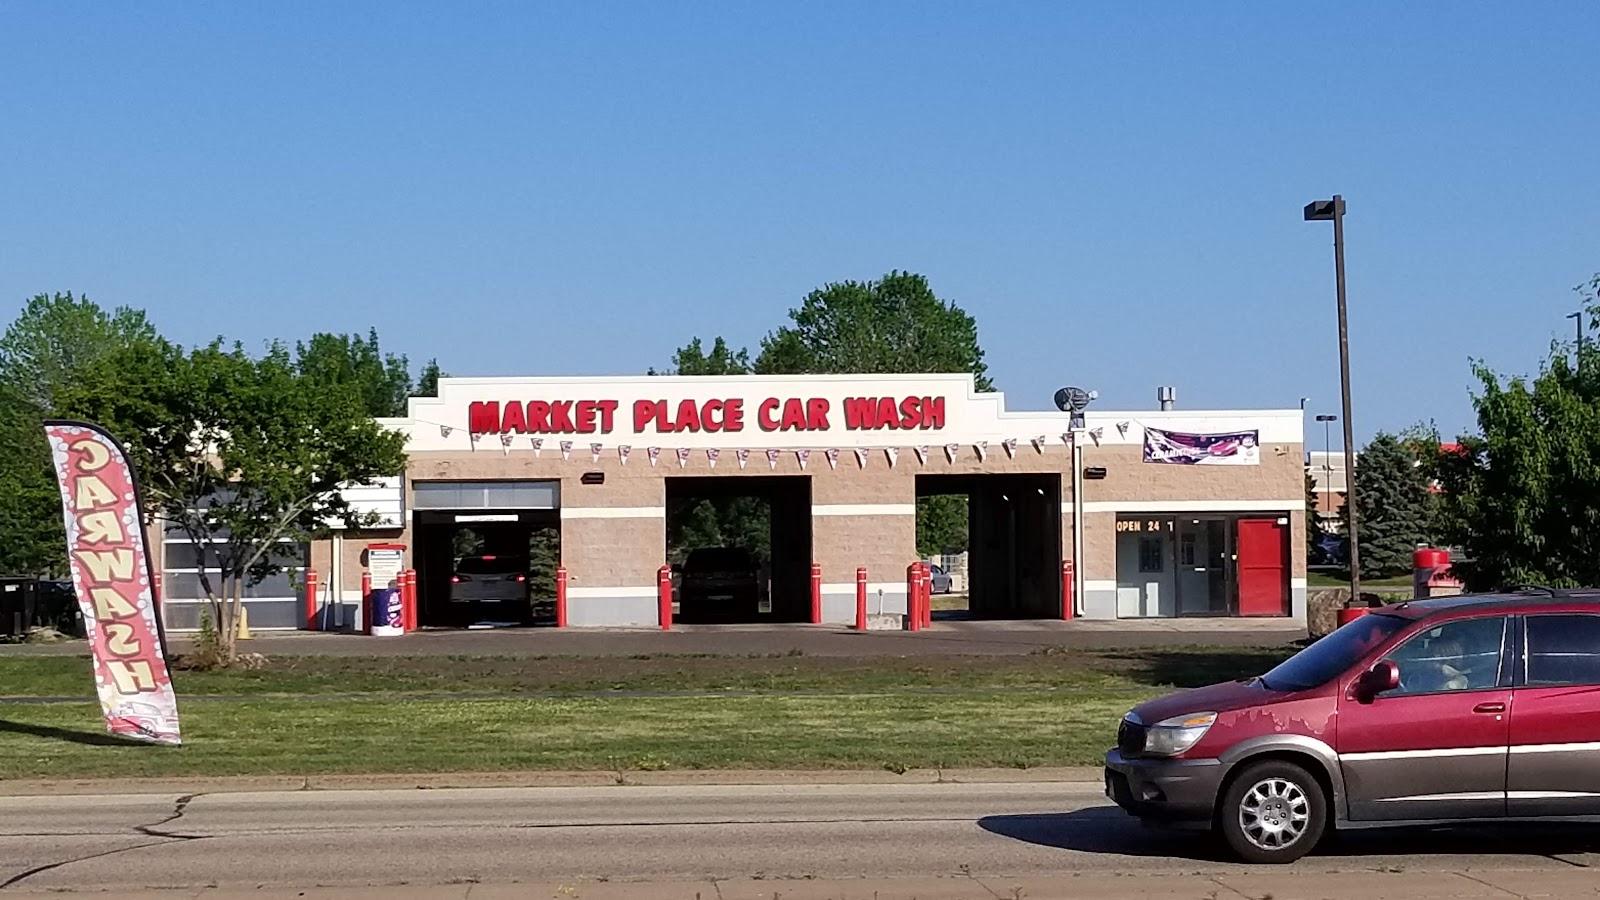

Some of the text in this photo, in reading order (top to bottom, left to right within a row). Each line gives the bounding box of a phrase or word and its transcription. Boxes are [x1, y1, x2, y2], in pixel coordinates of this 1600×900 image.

[468, 396, 946, 435] MARKET PLACE CAR WASH
[1116, 520, 1141, 532] OPEN
[1147, 520, 1160, 532] 24
